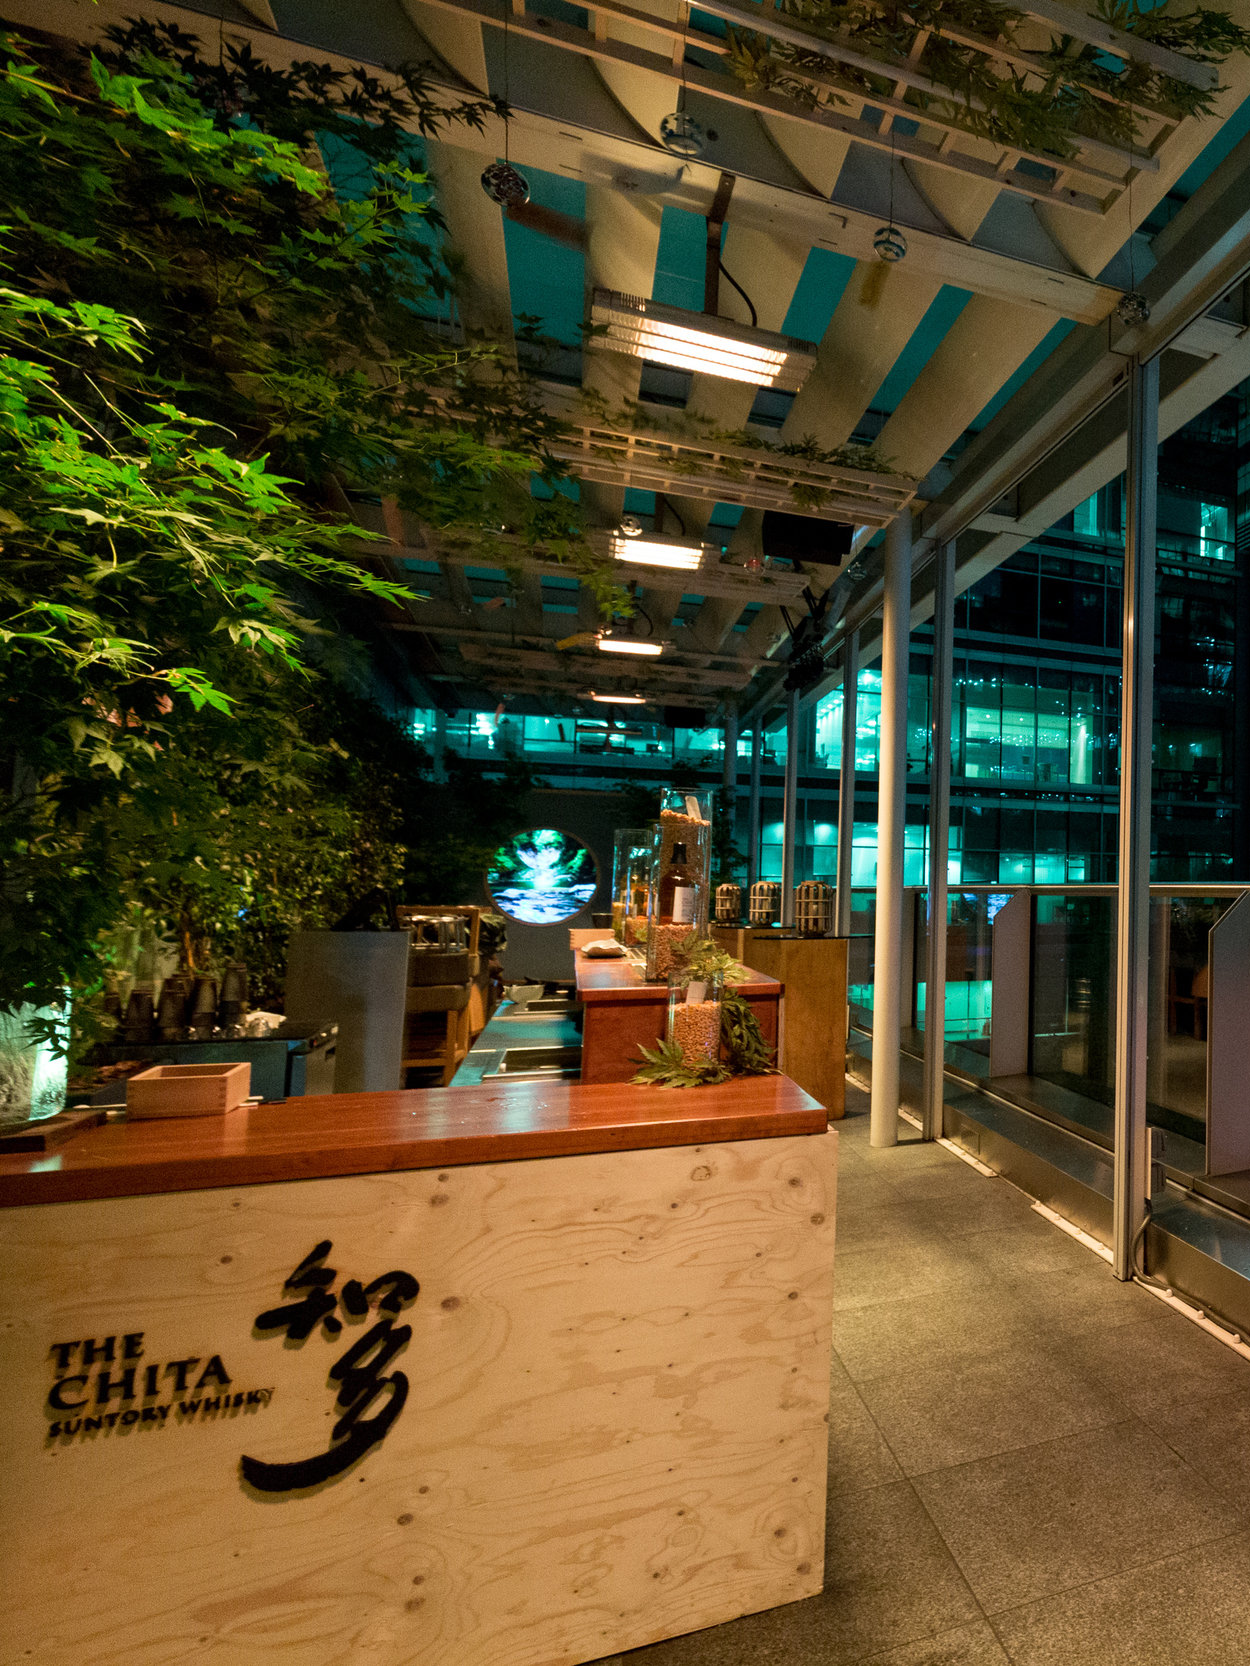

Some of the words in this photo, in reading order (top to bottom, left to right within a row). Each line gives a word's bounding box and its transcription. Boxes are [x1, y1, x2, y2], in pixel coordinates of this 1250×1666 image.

[50, 1332, 145, 1369] THE
[48, 1355, 232, 1410] CHITA
[50, 1405, 170, 1438] SUNTORY
[179, 1387, 276, 1416] WHISKY
